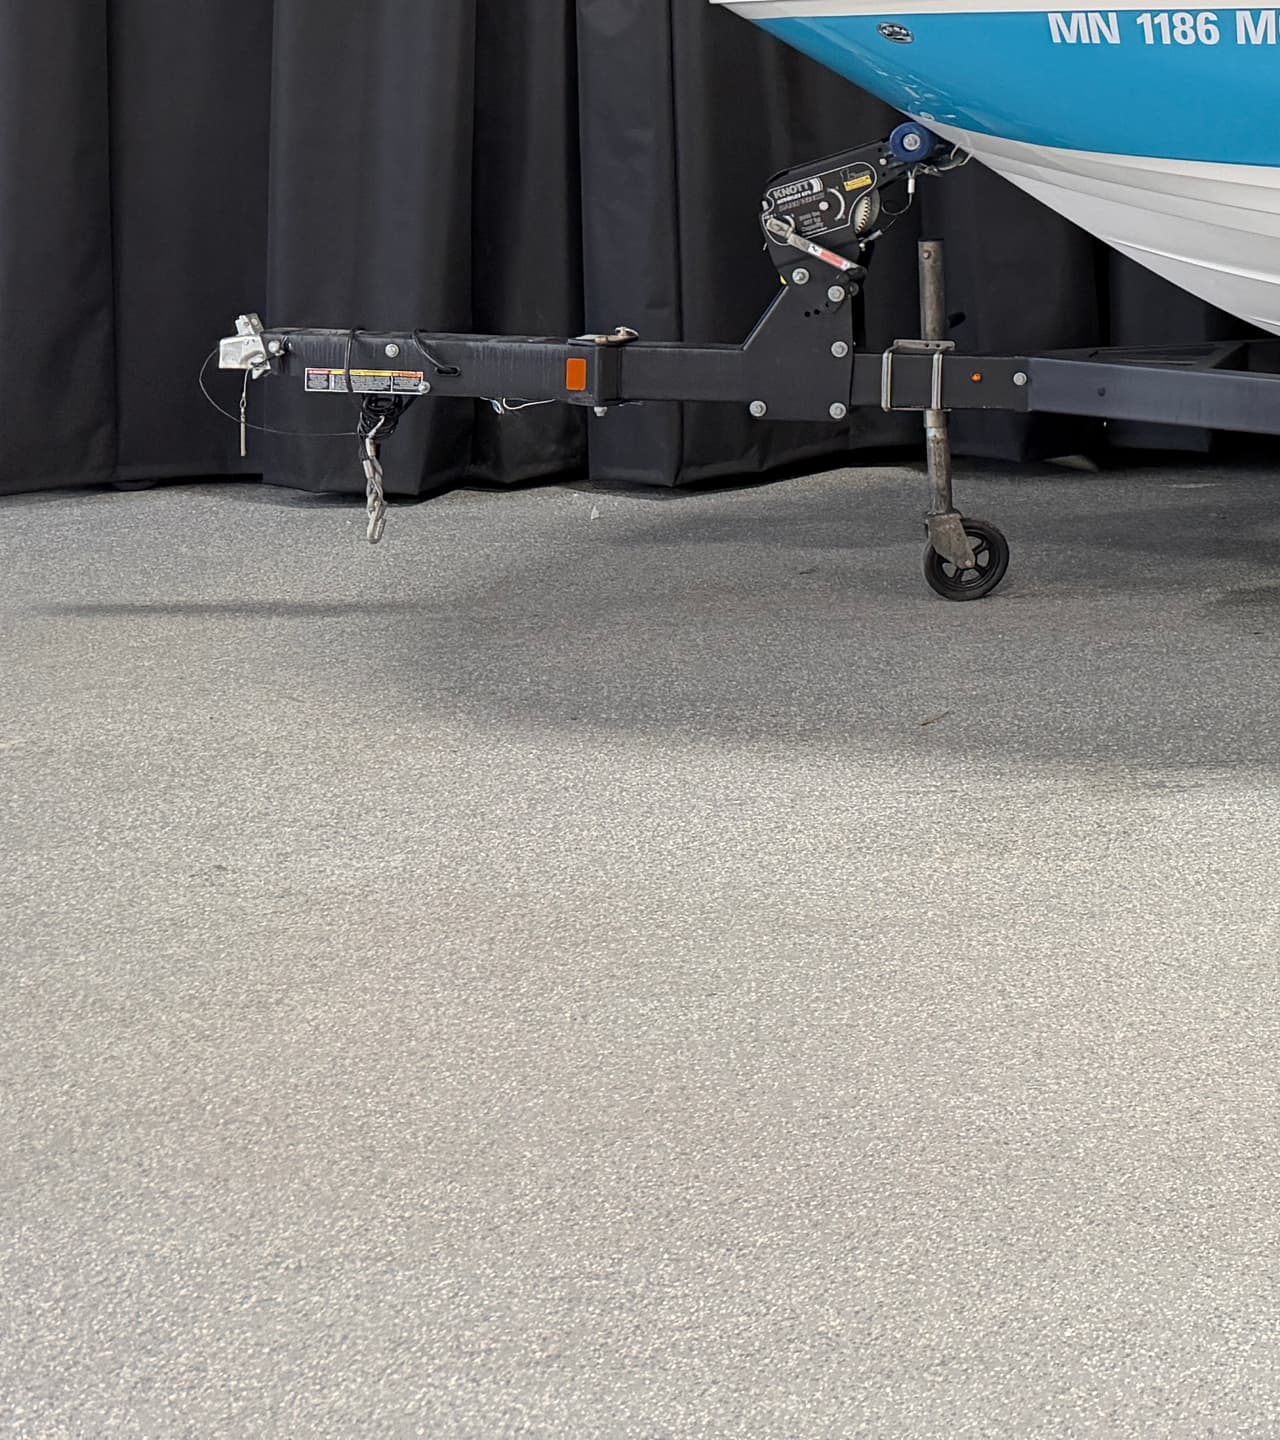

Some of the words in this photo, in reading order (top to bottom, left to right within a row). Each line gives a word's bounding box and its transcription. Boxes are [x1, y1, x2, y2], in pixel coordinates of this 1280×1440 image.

[1048, 12, 1120, 44] MN
[1136, 12, 1220, 45] 1186
[773, 180, 809, 199] KNOTT
